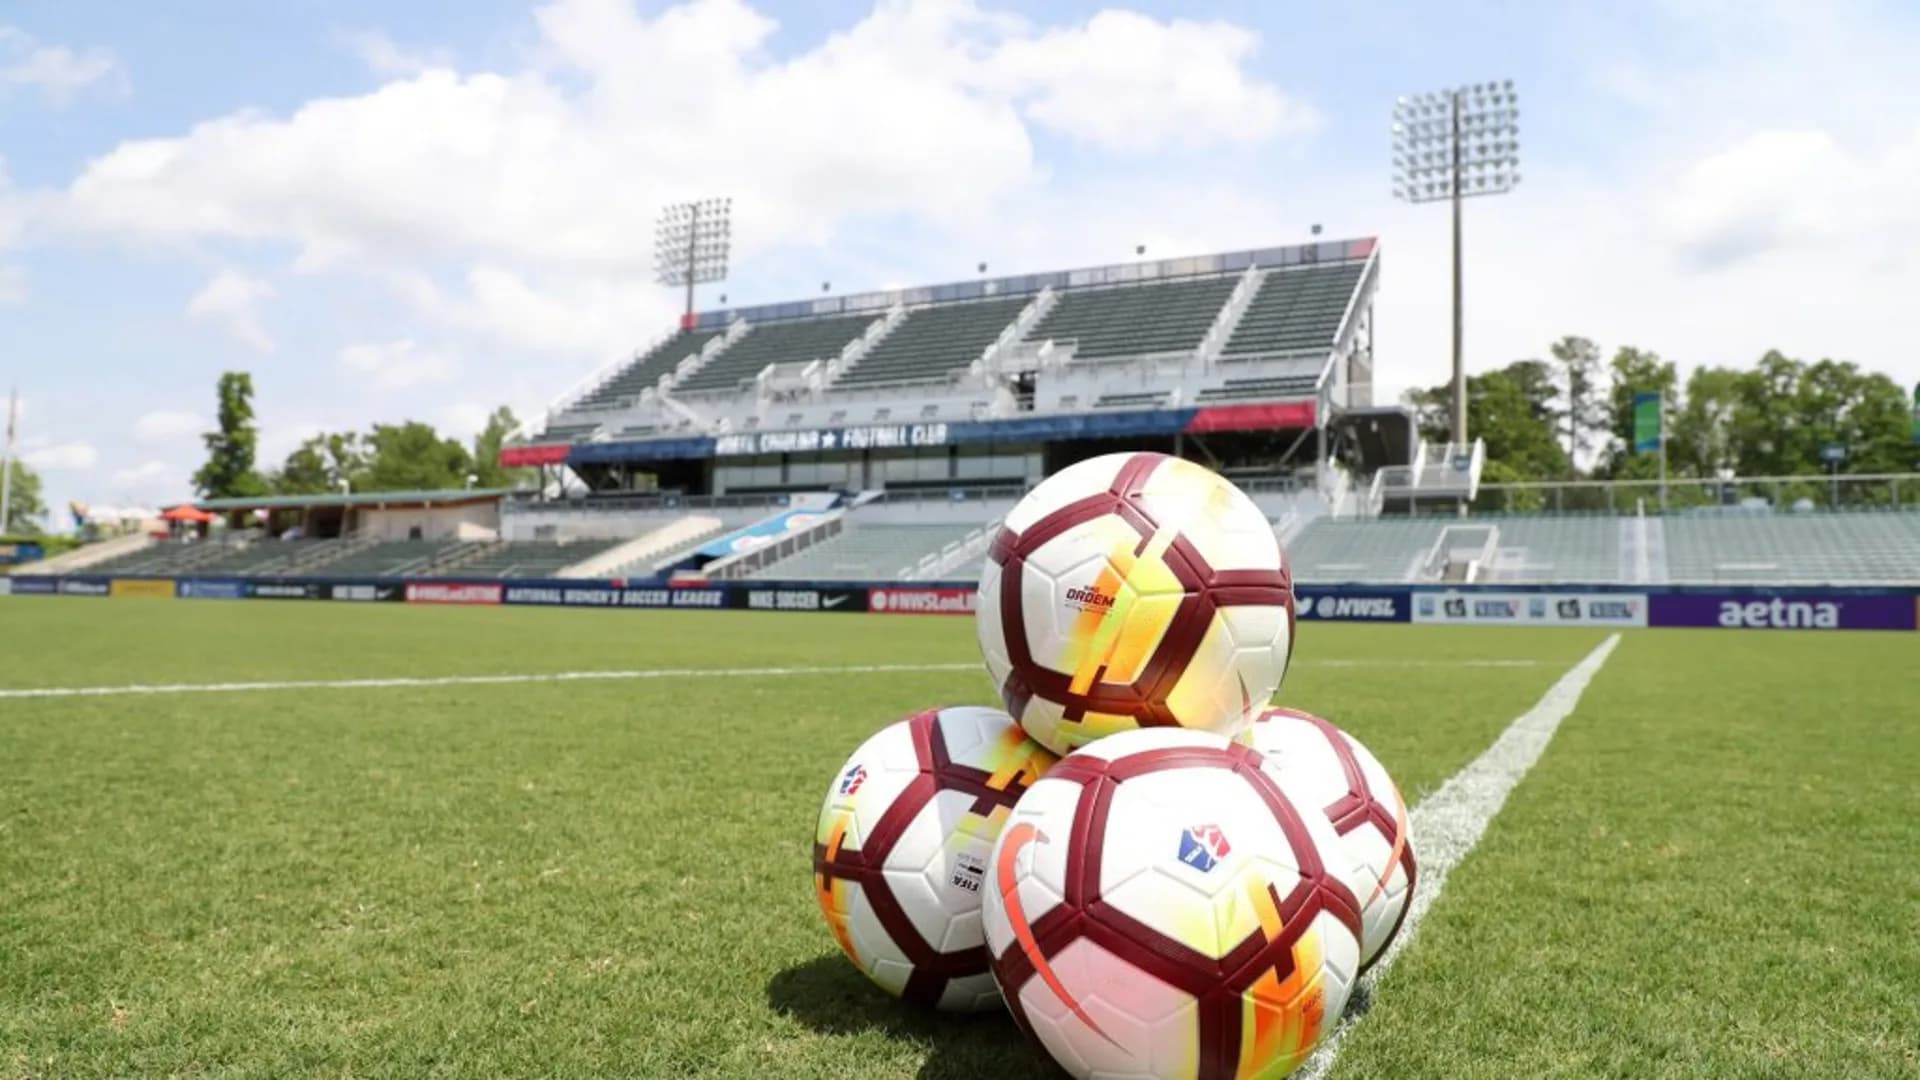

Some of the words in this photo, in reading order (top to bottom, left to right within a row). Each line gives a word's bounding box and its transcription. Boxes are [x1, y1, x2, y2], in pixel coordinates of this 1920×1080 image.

[843, 425, 907, 448] FOOTBALL
[912, 423, 948, 446] CLUB
[506, 588, 561, 603] NATIONAL
[563, 588, 620, 605] WOMEN'S
[623, 589, 669, 606] SOCCER
[672, 590, 722, 606] LEAGUE
[748, 590, 774, 609] NIKE
[776, 590, 819, 609] SOCCER
[1066, 587, 1116, 608] ORDEM
[1316, 596, 1396, 619] @NWSL
[1718, 597, 1840, 628] aetna
[952, 875, 980, 892] FIFA
